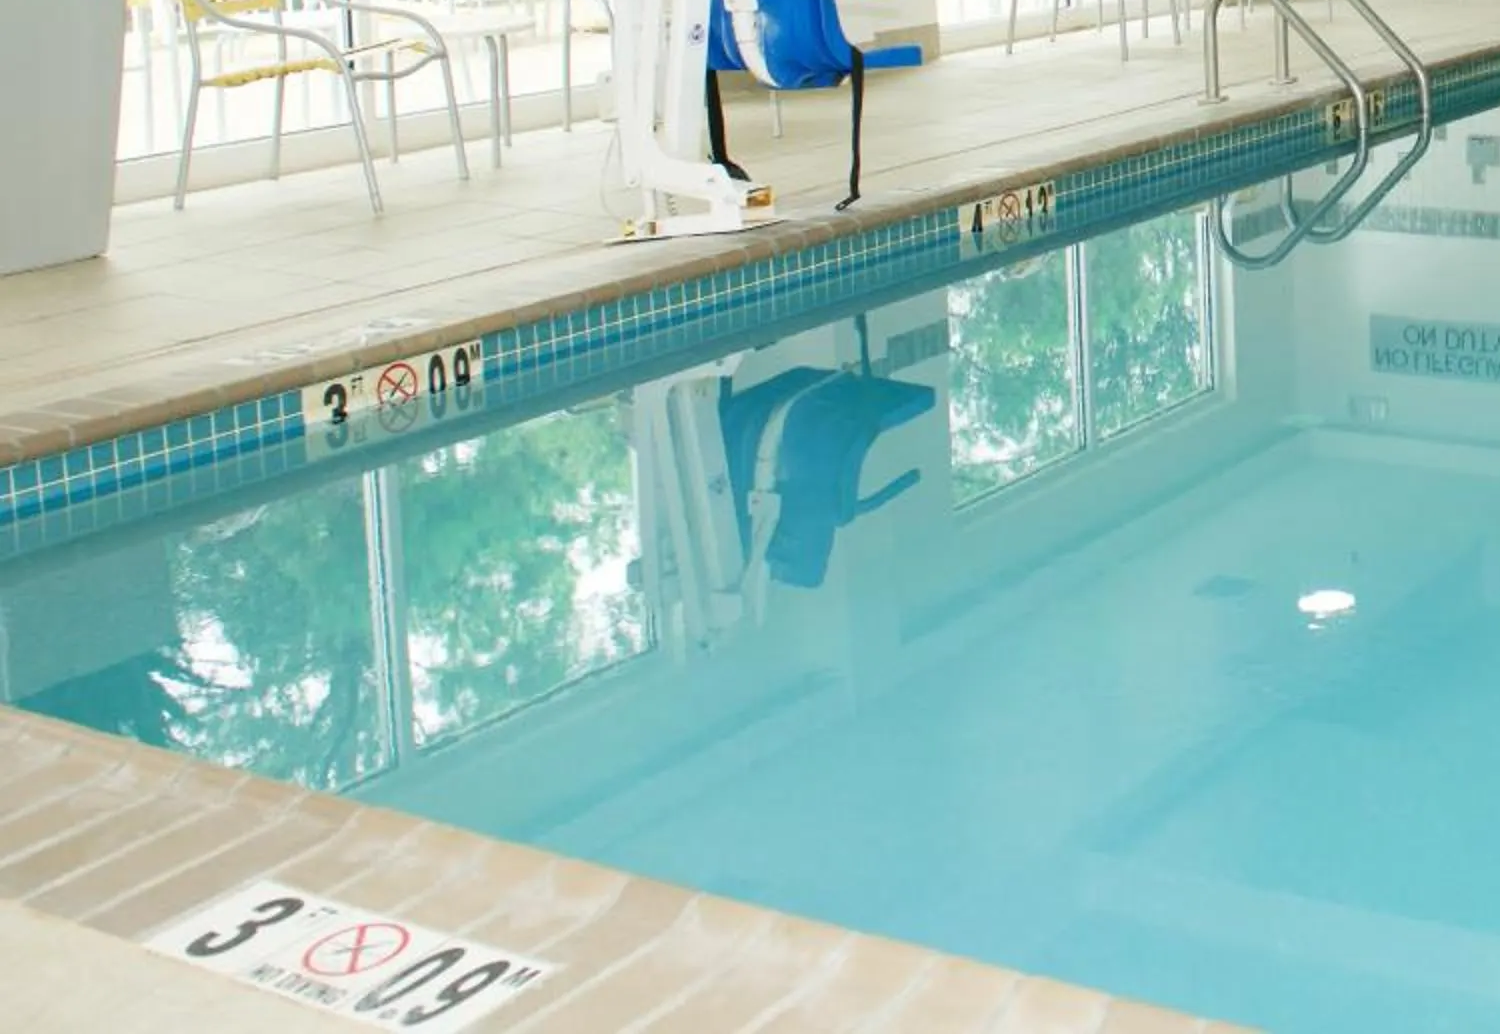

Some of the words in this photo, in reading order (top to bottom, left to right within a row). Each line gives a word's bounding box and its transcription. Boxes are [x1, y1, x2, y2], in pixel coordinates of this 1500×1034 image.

[185, 897, 305, 958] 3
[353, 946, 511, 1027] 0.9
[503, 965, 542, 988] M
